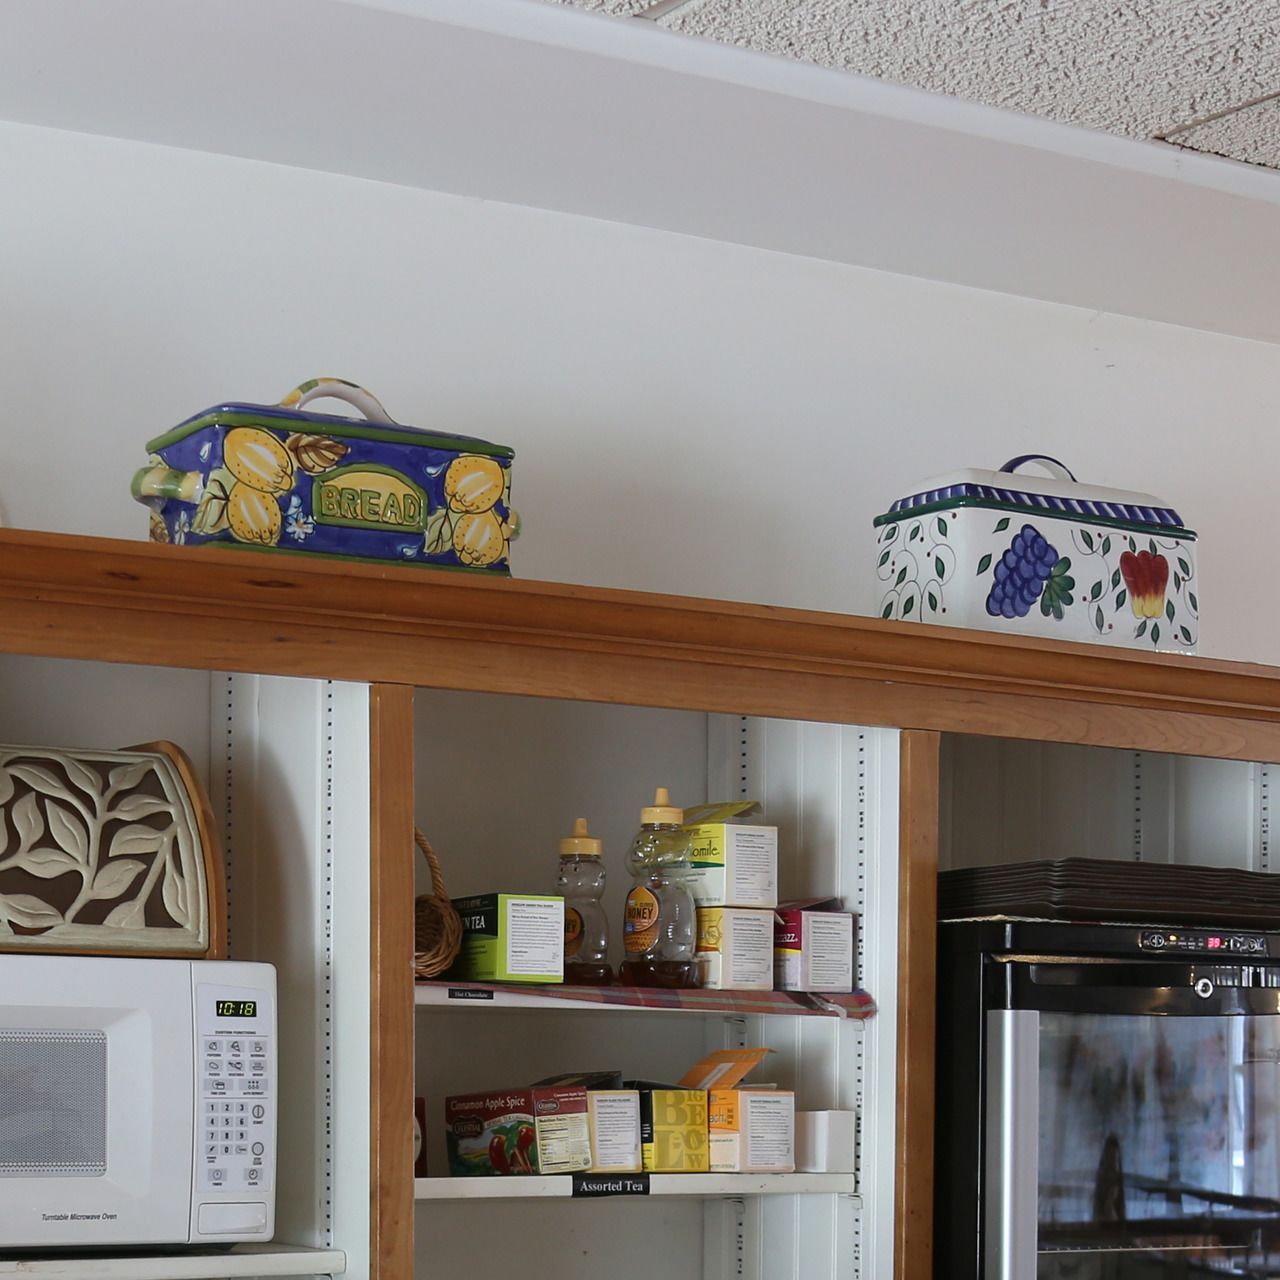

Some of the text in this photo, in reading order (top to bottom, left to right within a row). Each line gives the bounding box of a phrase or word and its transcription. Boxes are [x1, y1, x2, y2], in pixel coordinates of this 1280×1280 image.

[320, 484, 421, 524] BREAD
[627, 908, 654, 919] HONEY
[471, 915, 486, 929] TEA
[1207, 937, 1221, 948] 39
[218, 1002, 254, 1015] 10:18
[450, 1096, 525, 1111] Cinnamon Apple Spice
[580, 1180, 644, 1192] Assorted Tea
[70, 1213, 100, 1221] Microwave
[101, 1212, 118, 1220] Oven
